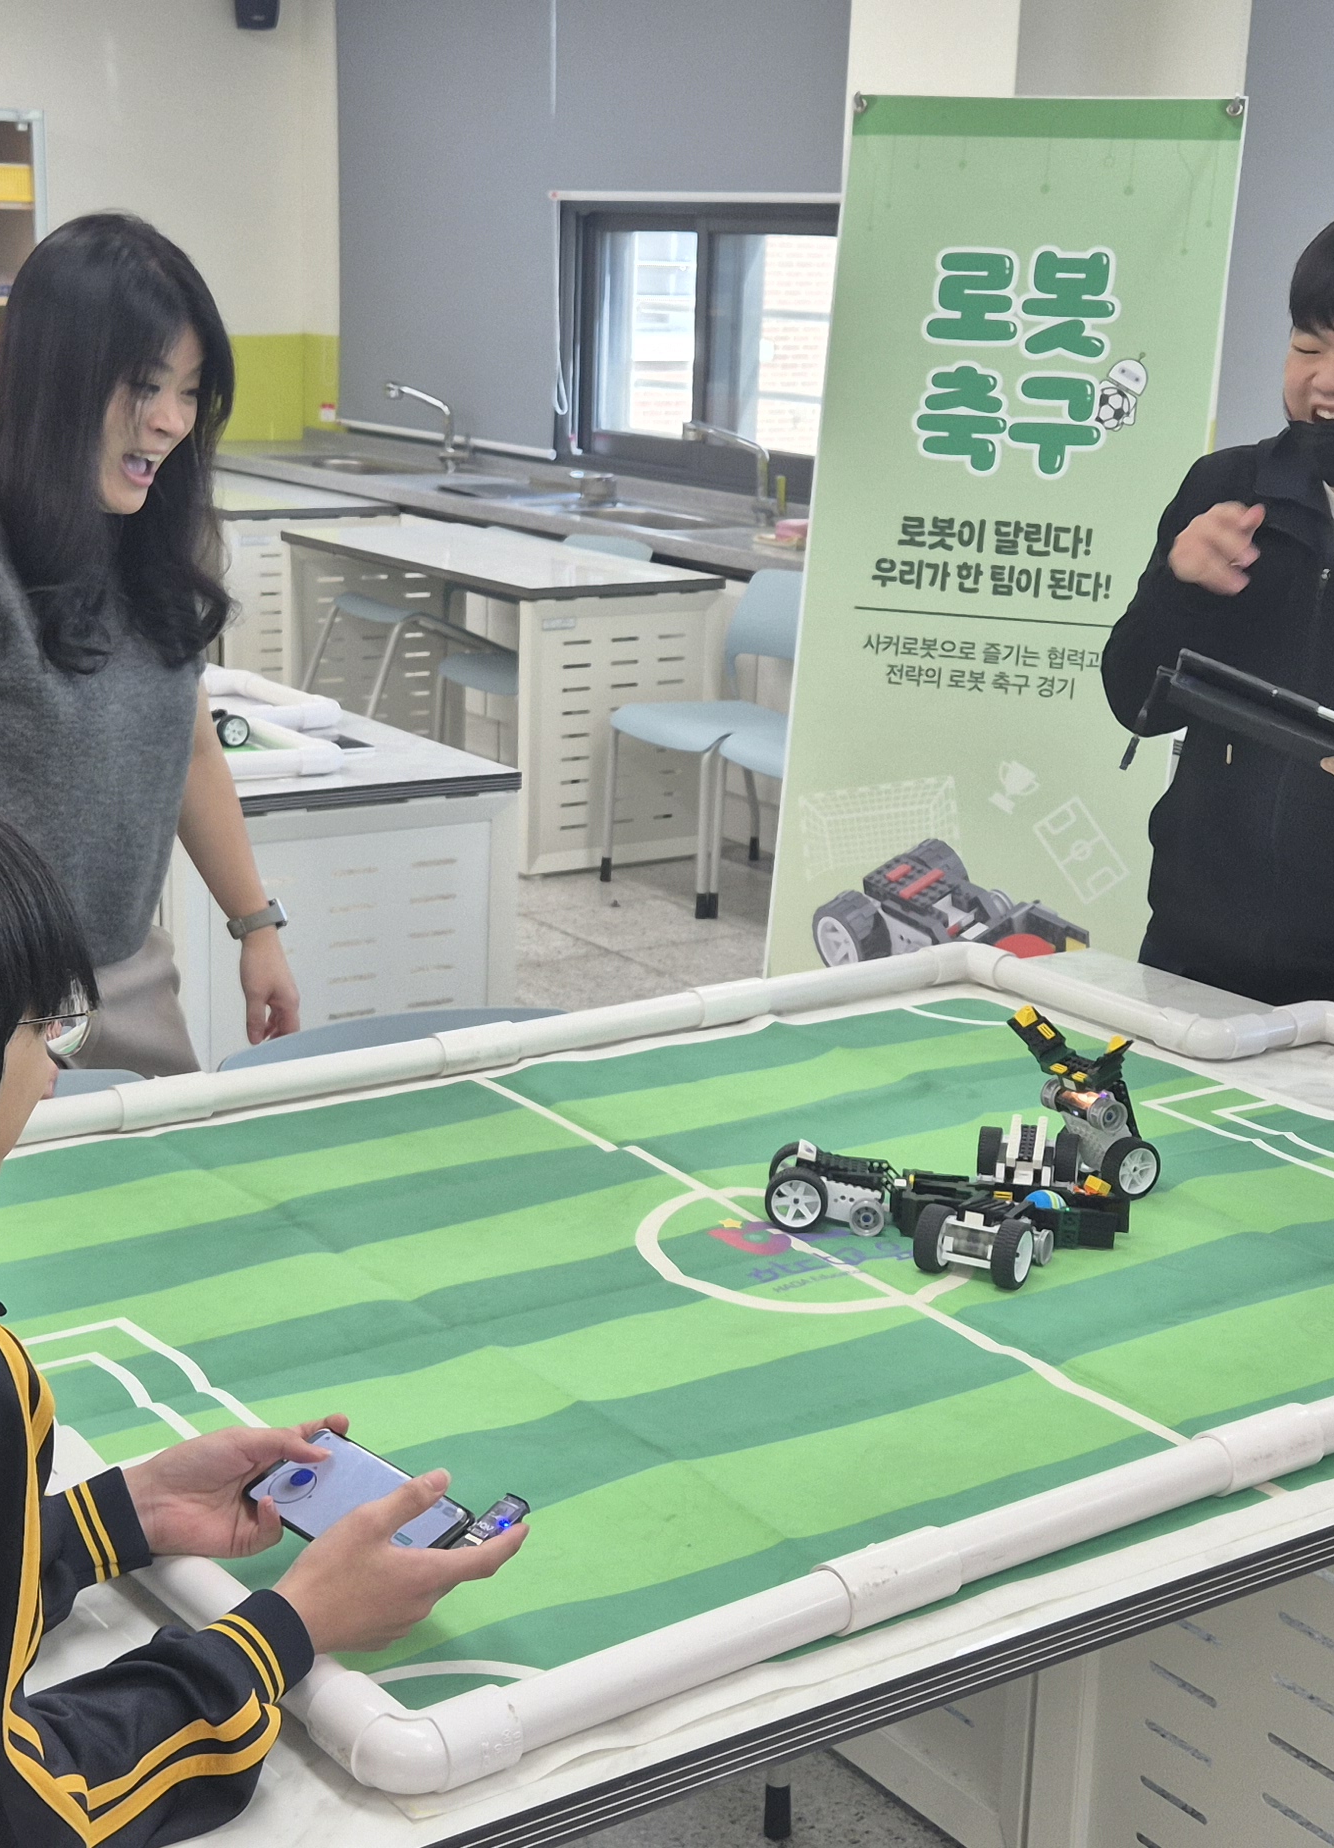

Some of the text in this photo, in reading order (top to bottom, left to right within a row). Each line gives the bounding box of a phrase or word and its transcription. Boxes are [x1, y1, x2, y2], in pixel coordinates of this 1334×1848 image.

[924, 247, 1119, 361] 로봇
[914, 362, 1104, 478] 축구
[897, 516, 1093, 559] 로봇이 달린다!
[871, 558, 1112, 602] 우리가 한 팀이 된다!
[862, 633, 976, 661] 사커로봇으로
[982, 641, 1041, 668] 즐기는
[885, 663, 1076, 700] 전략의 로봇 축구 경기
